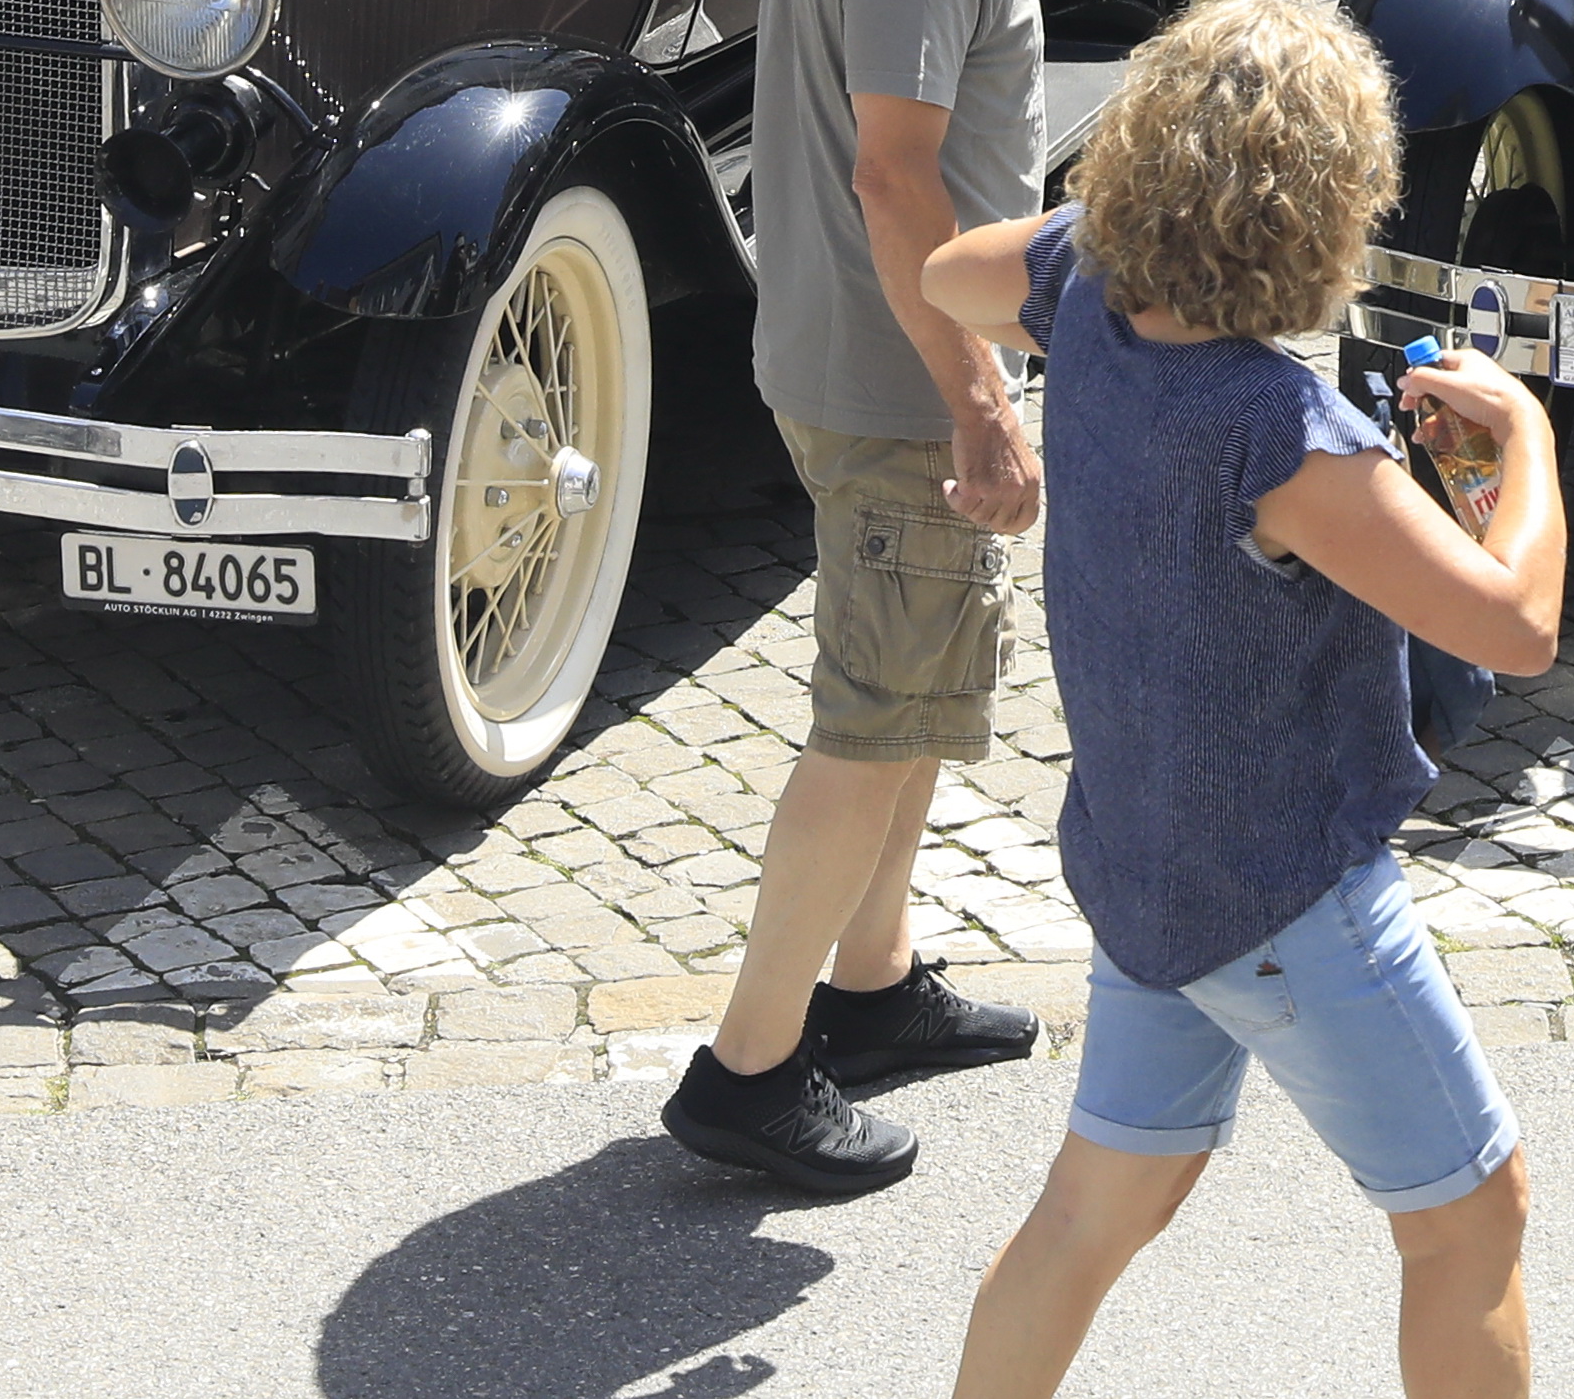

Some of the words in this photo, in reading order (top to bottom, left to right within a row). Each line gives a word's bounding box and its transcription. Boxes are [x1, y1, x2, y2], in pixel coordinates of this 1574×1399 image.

[104, 603, 131, 613] AUTO
[133, 604, 180, 616] STÖCKLIN
[183, 607, 197, 618] AG
[209, 609, 232, 620] 4222
[234, 611, 274, 622] Zwingen
